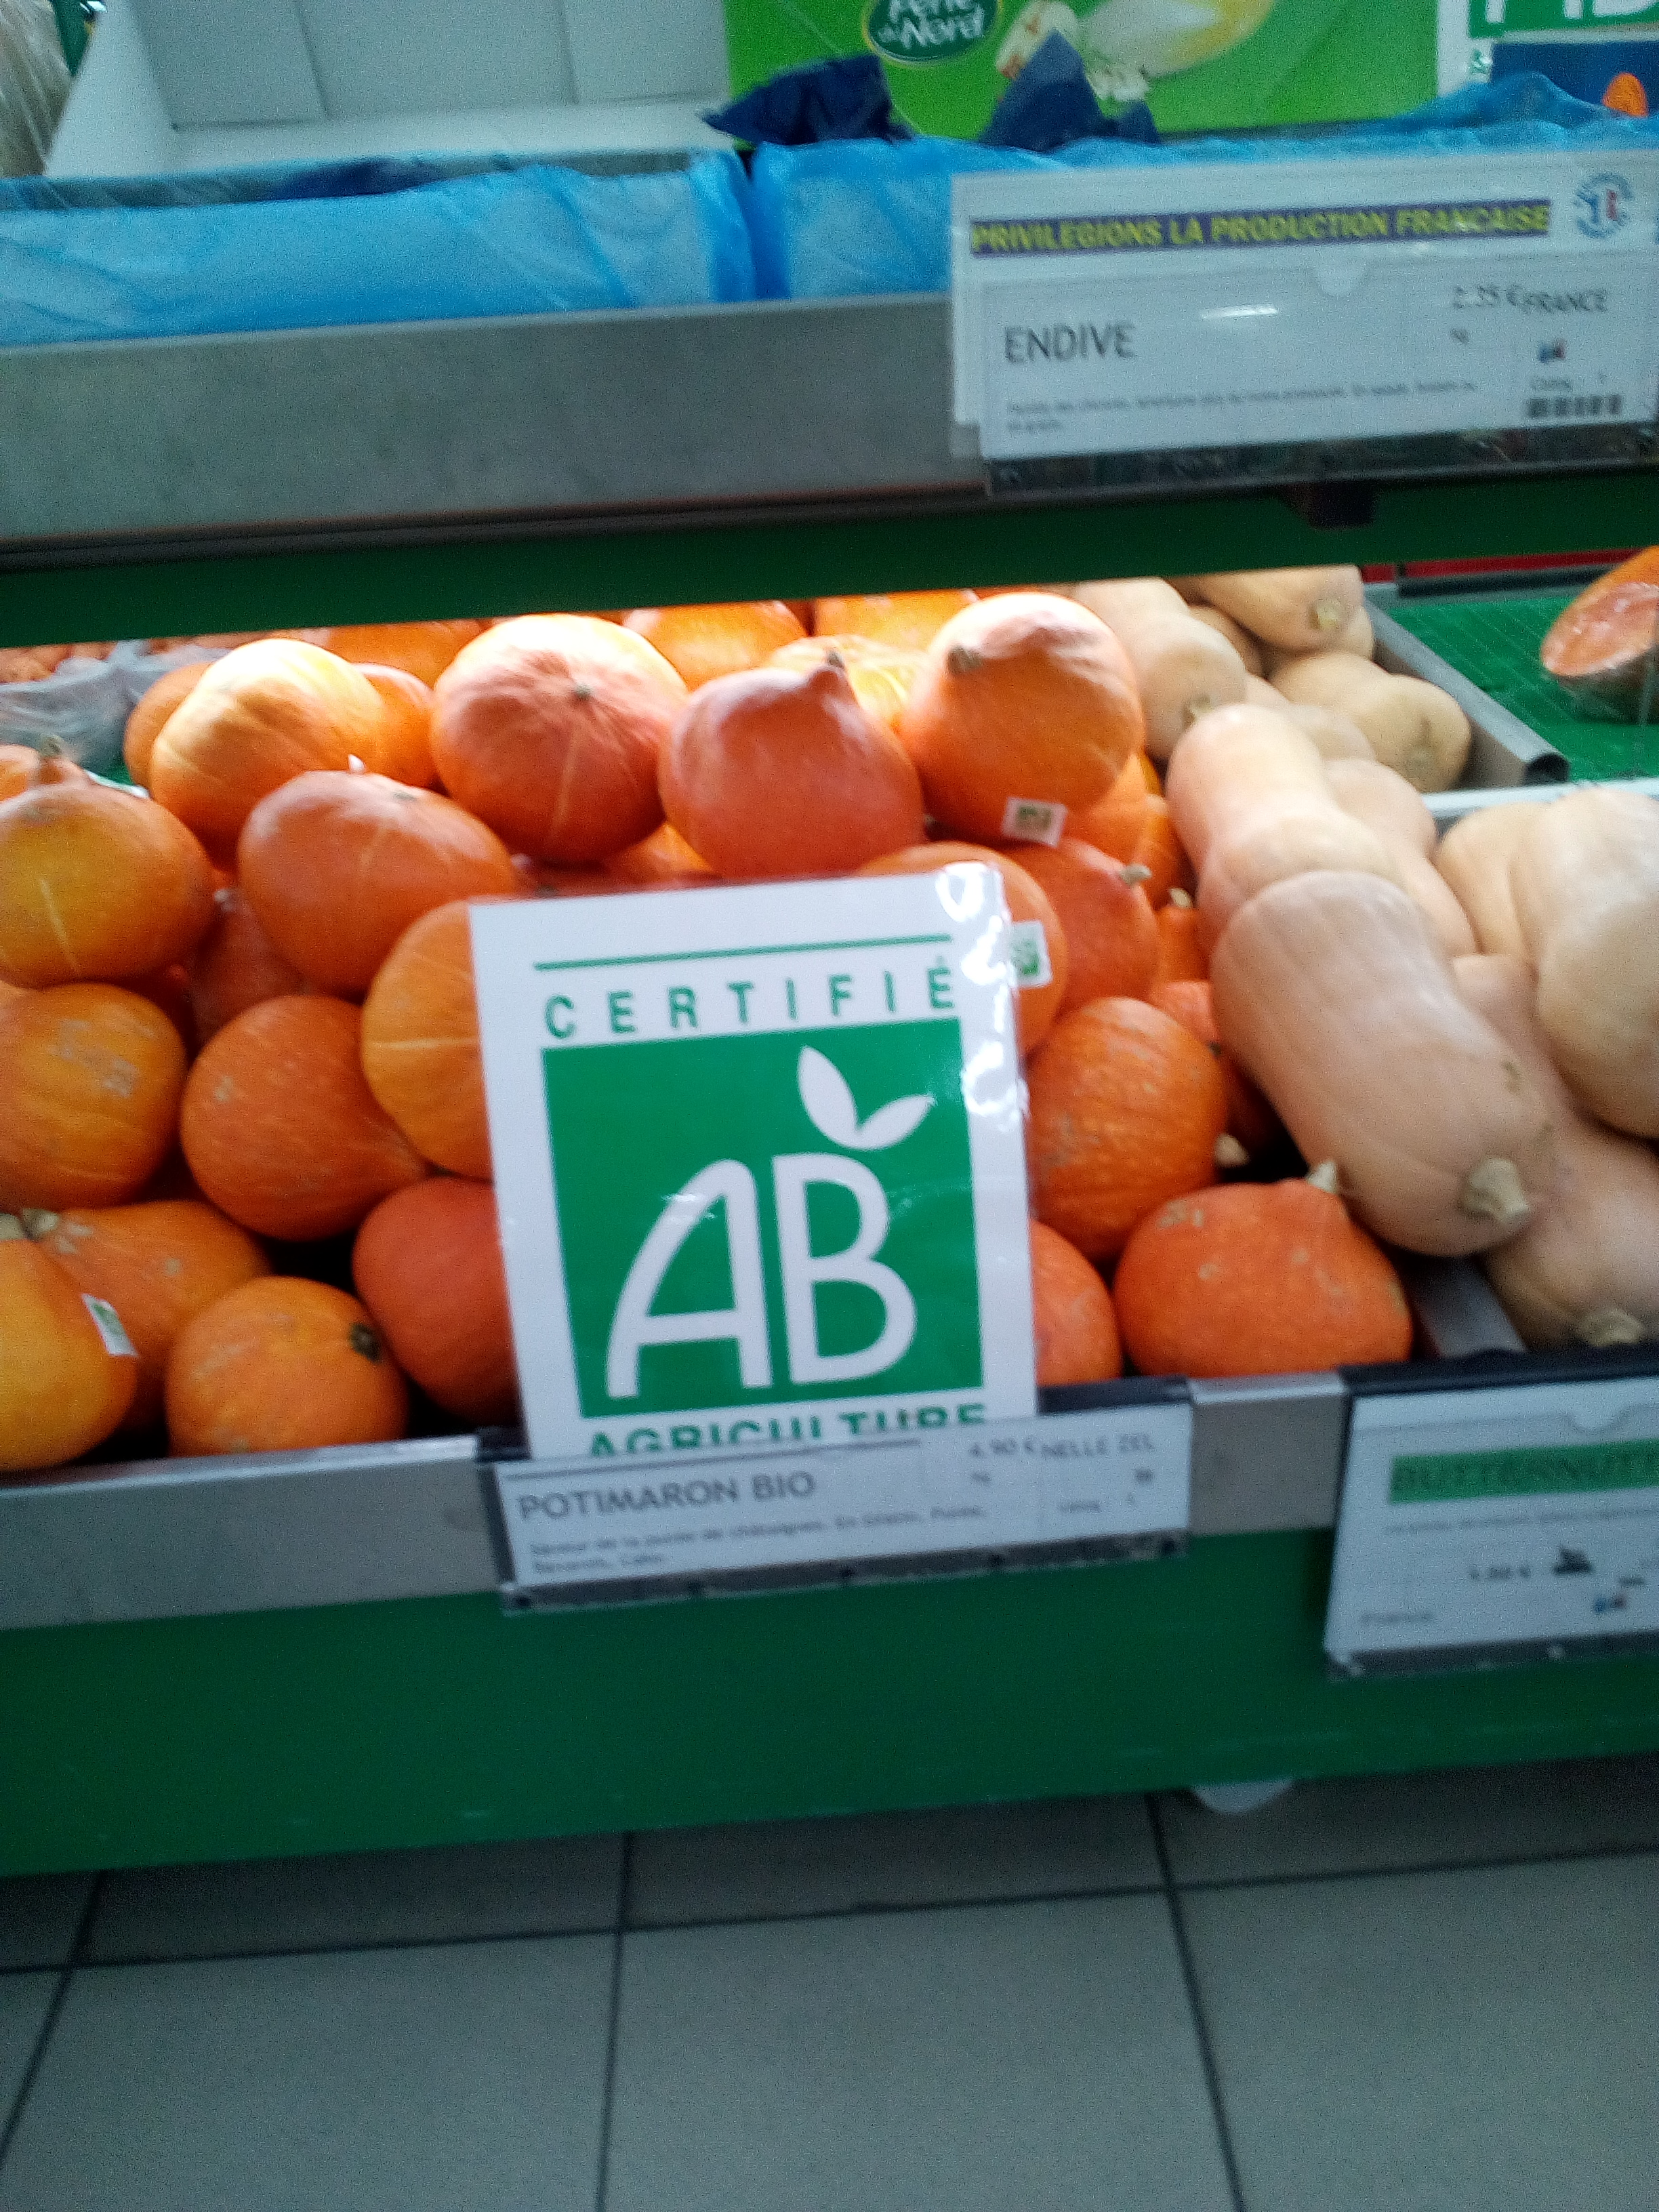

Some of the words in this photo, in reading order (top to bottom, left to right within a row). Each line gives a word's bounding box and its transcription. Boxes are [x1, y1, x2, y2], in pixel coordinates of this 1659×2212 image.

[900, 3, 985, 49] Nord
[1170, 217, 1203, 245] LA
[1212, 212, 1389, 243] PRODUCTION
[1004, 322, 1136, 363] ENDIVE
[544, 956, 954, 1038] CERTIFIÉ
[605, 1152, 918, 1399] AB
[518, 1479, 739, 1519] POTIMARON
[750, 1471, 815, 1501] BIO
